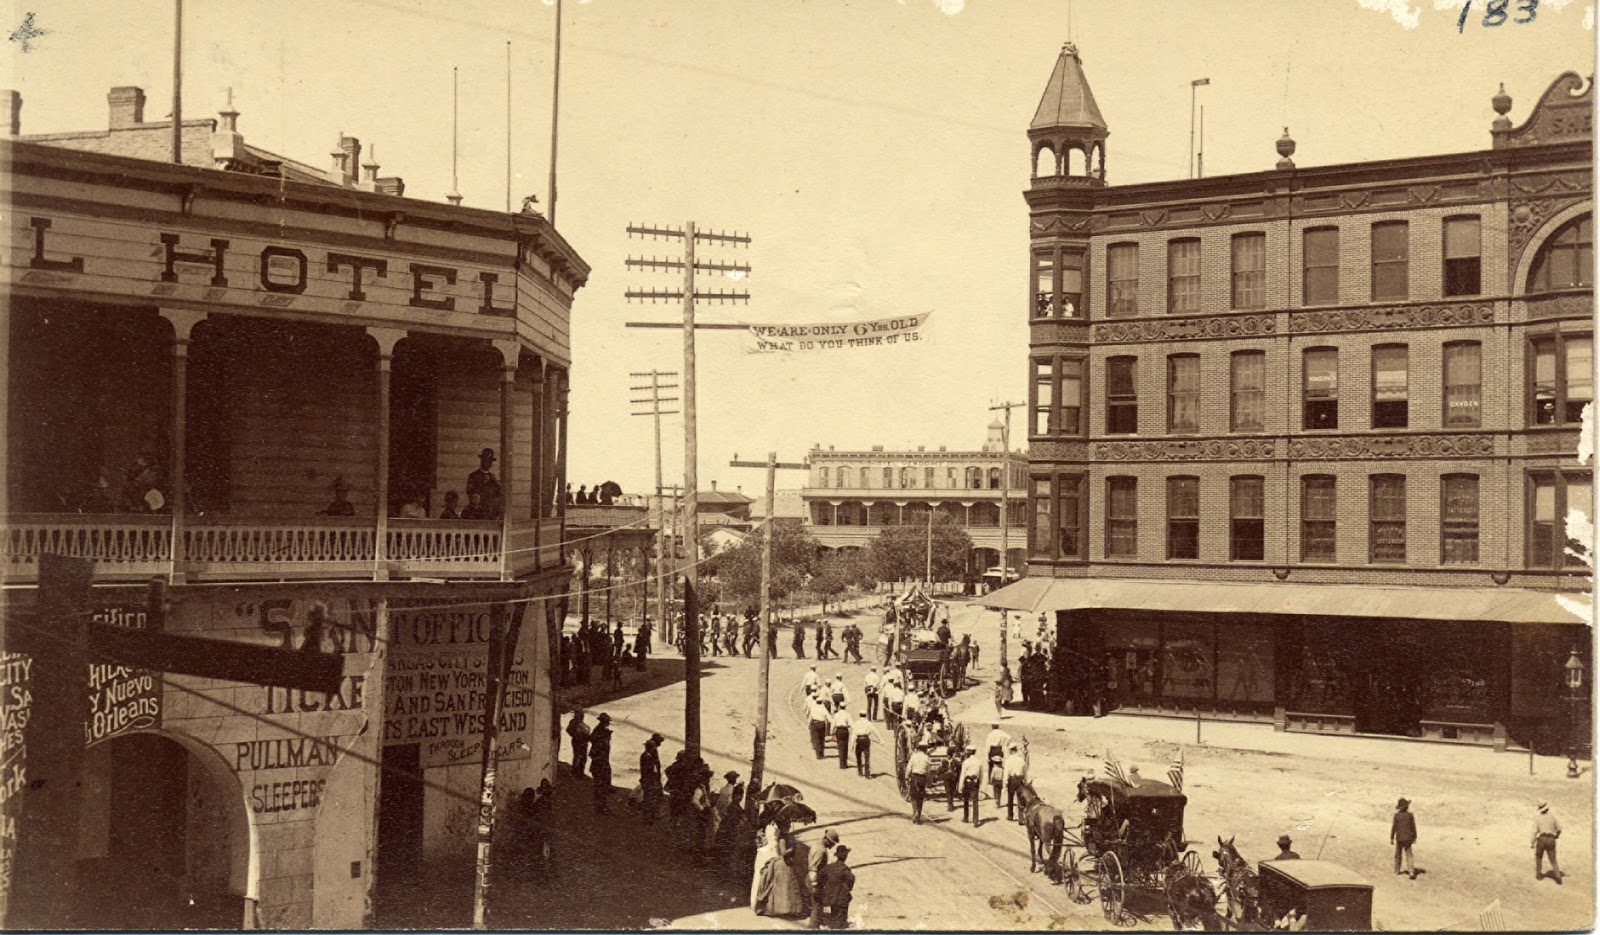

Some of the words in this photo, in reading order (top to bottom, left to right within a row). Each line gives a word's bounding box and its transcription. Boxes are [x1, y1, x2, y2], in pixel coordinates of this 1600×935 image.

[160, 233, 518, 316] HOTEL
[757, 341, 794, 351] WHAT
[800, 341, 815, 350] DO
[820, 340, 844, 349] YOU
[848, 337, 883, 348] THINK
[886, 335, 899, 344] OF
[812, 325, 849, 338] ONLY
[853, 323, 869, 336] 6
[890, 317, 919, 333] OLD
[104, 675, 153, 715] Nuevo
[262, 675, 364, 714] TICKE
[420, 671, 451, 691] NEW
[453, 670, 487, 690] YORK
[93, 697, 159, 739] Orleans
[393, 695, 431, 715] AND
[434, 691, 467, 713] SAN
[408, 716, 450, 739] EAST
[453, 713, 488, 735] WES
[500, 712, 527, 733] AND
[236, 736, 338, 772] PULLMAN
[428, 740, 466, 758] THROUGH
[252, 779, 328, 814] SLEEPERS
